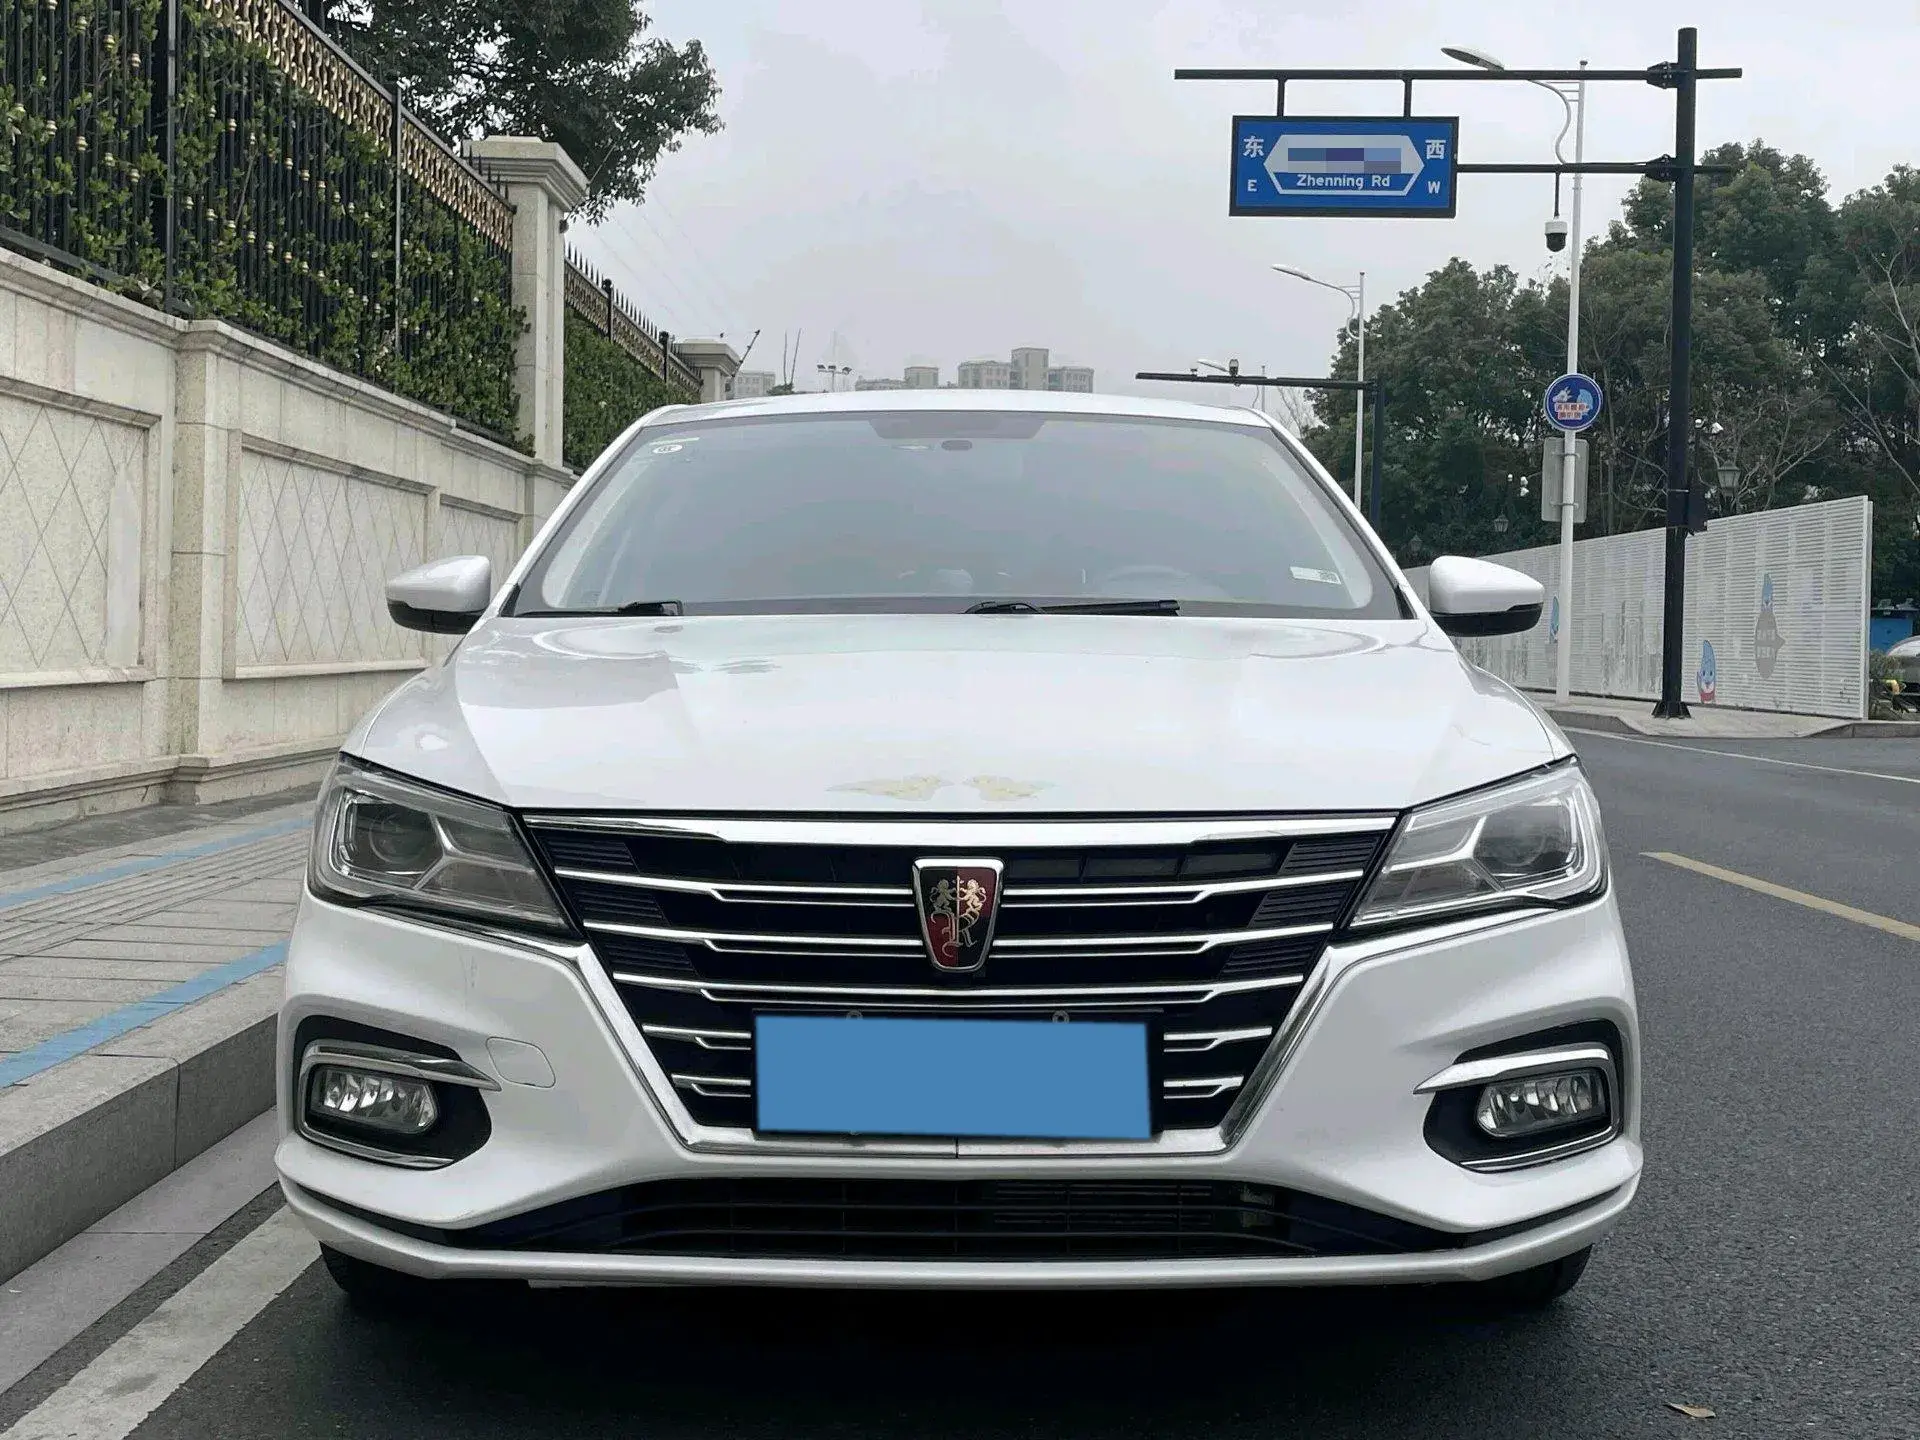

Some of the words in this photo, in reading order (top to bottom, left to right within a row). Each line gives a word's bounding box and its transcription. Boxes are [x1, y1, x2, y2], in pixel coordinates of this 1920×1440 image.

[1243, 135, 1264, 158] 东
[1425, 139, 1447, 160] 西
[1247, 179, 1257, 192] E
[1296, 174, 1364, 190] Zhenning
[1371, 174, 1391, 187] Rd
[1427, 180, 1441, 194] W
